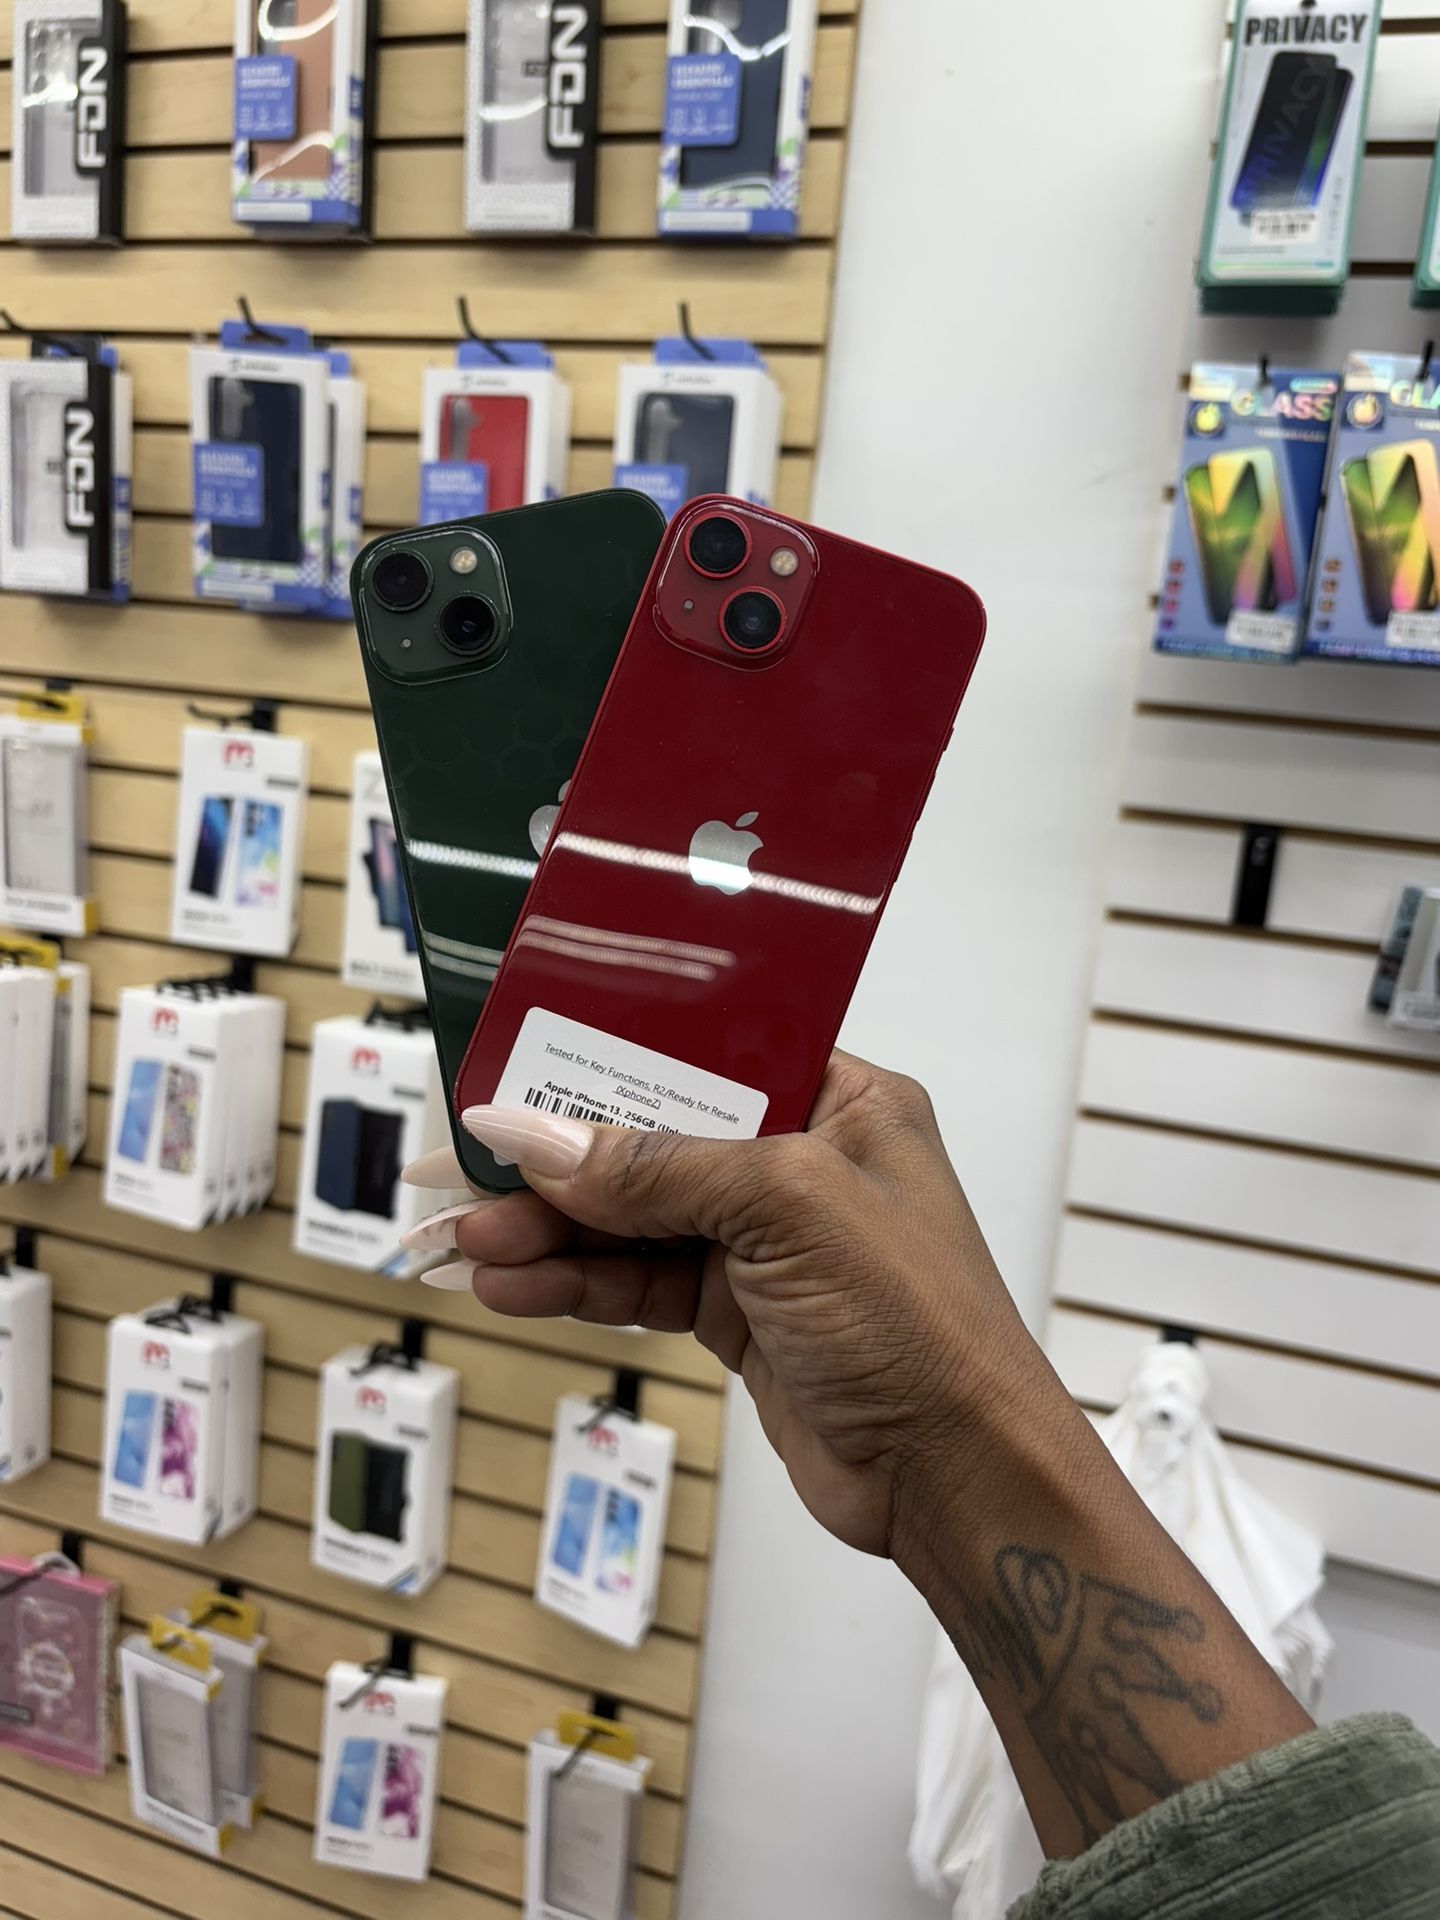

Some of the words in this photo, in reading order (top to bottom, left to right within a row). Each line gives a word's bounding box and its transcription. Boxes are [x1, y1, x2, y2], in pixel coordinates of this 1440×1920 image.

[1244, 14, 1368, 46] PRIVACY
[1231, 388, 1332, 421] GLASS
[544, 1043, 574, 1061] Tested
[575, 1054, 590, 1066] for
[590, 1060, 607, 1075] Key
[652, 1083, 696, 1109] R2/Ready
[697, 1100, 710, 1113] for
[711, 1105, 740, 1124] Resale
[614, 1085, 662, 1110] (XphoneZ)
[544, 1081, 573, 1098] Apple
[574, 1091, 608, 1111] iPhone
[624, 1110, 656, 1129] 256GB
